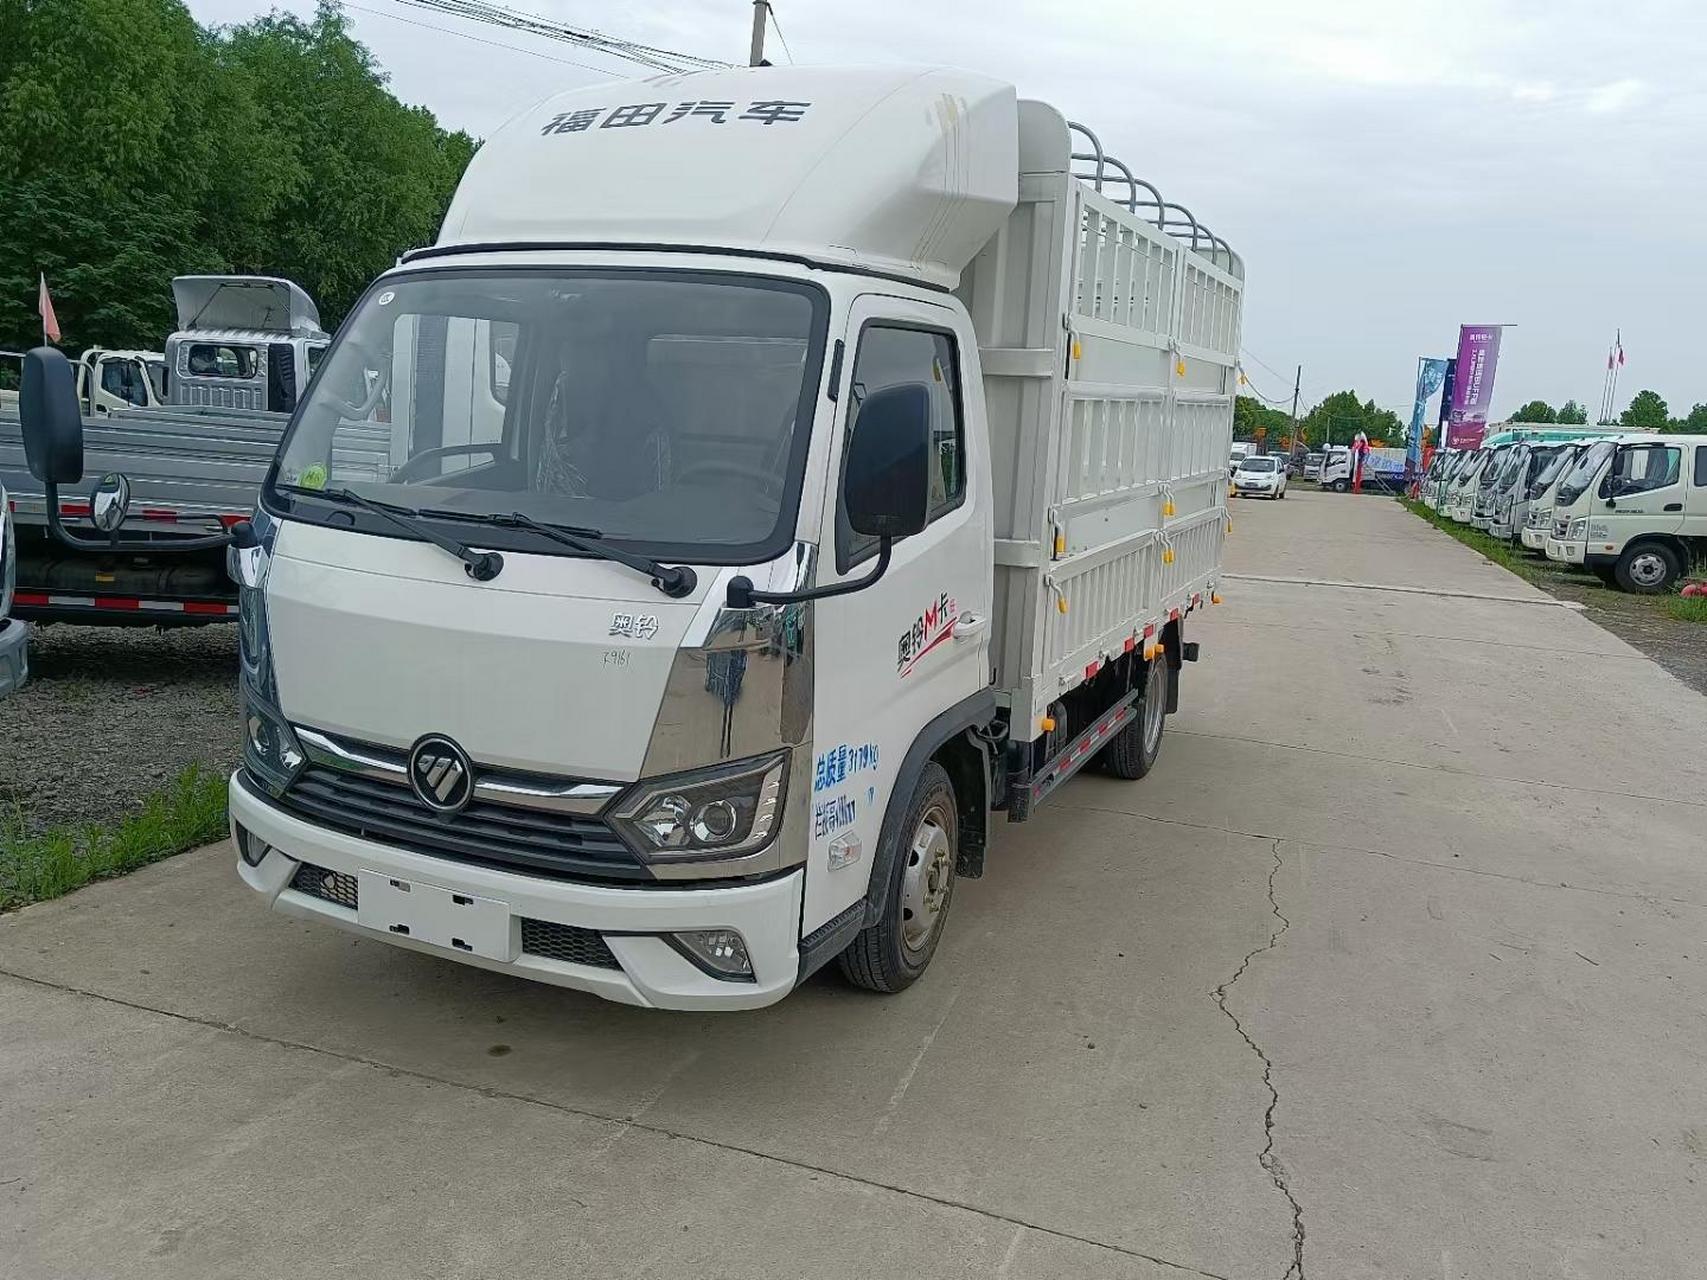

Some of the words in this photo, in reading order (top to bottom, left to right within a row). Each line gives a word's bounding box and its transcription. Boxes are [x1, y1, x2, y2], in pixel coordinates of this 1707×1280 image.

[541, 100, 812, 136] 福田汽车
[897, 592, 949, 673] 奥铃M卡
